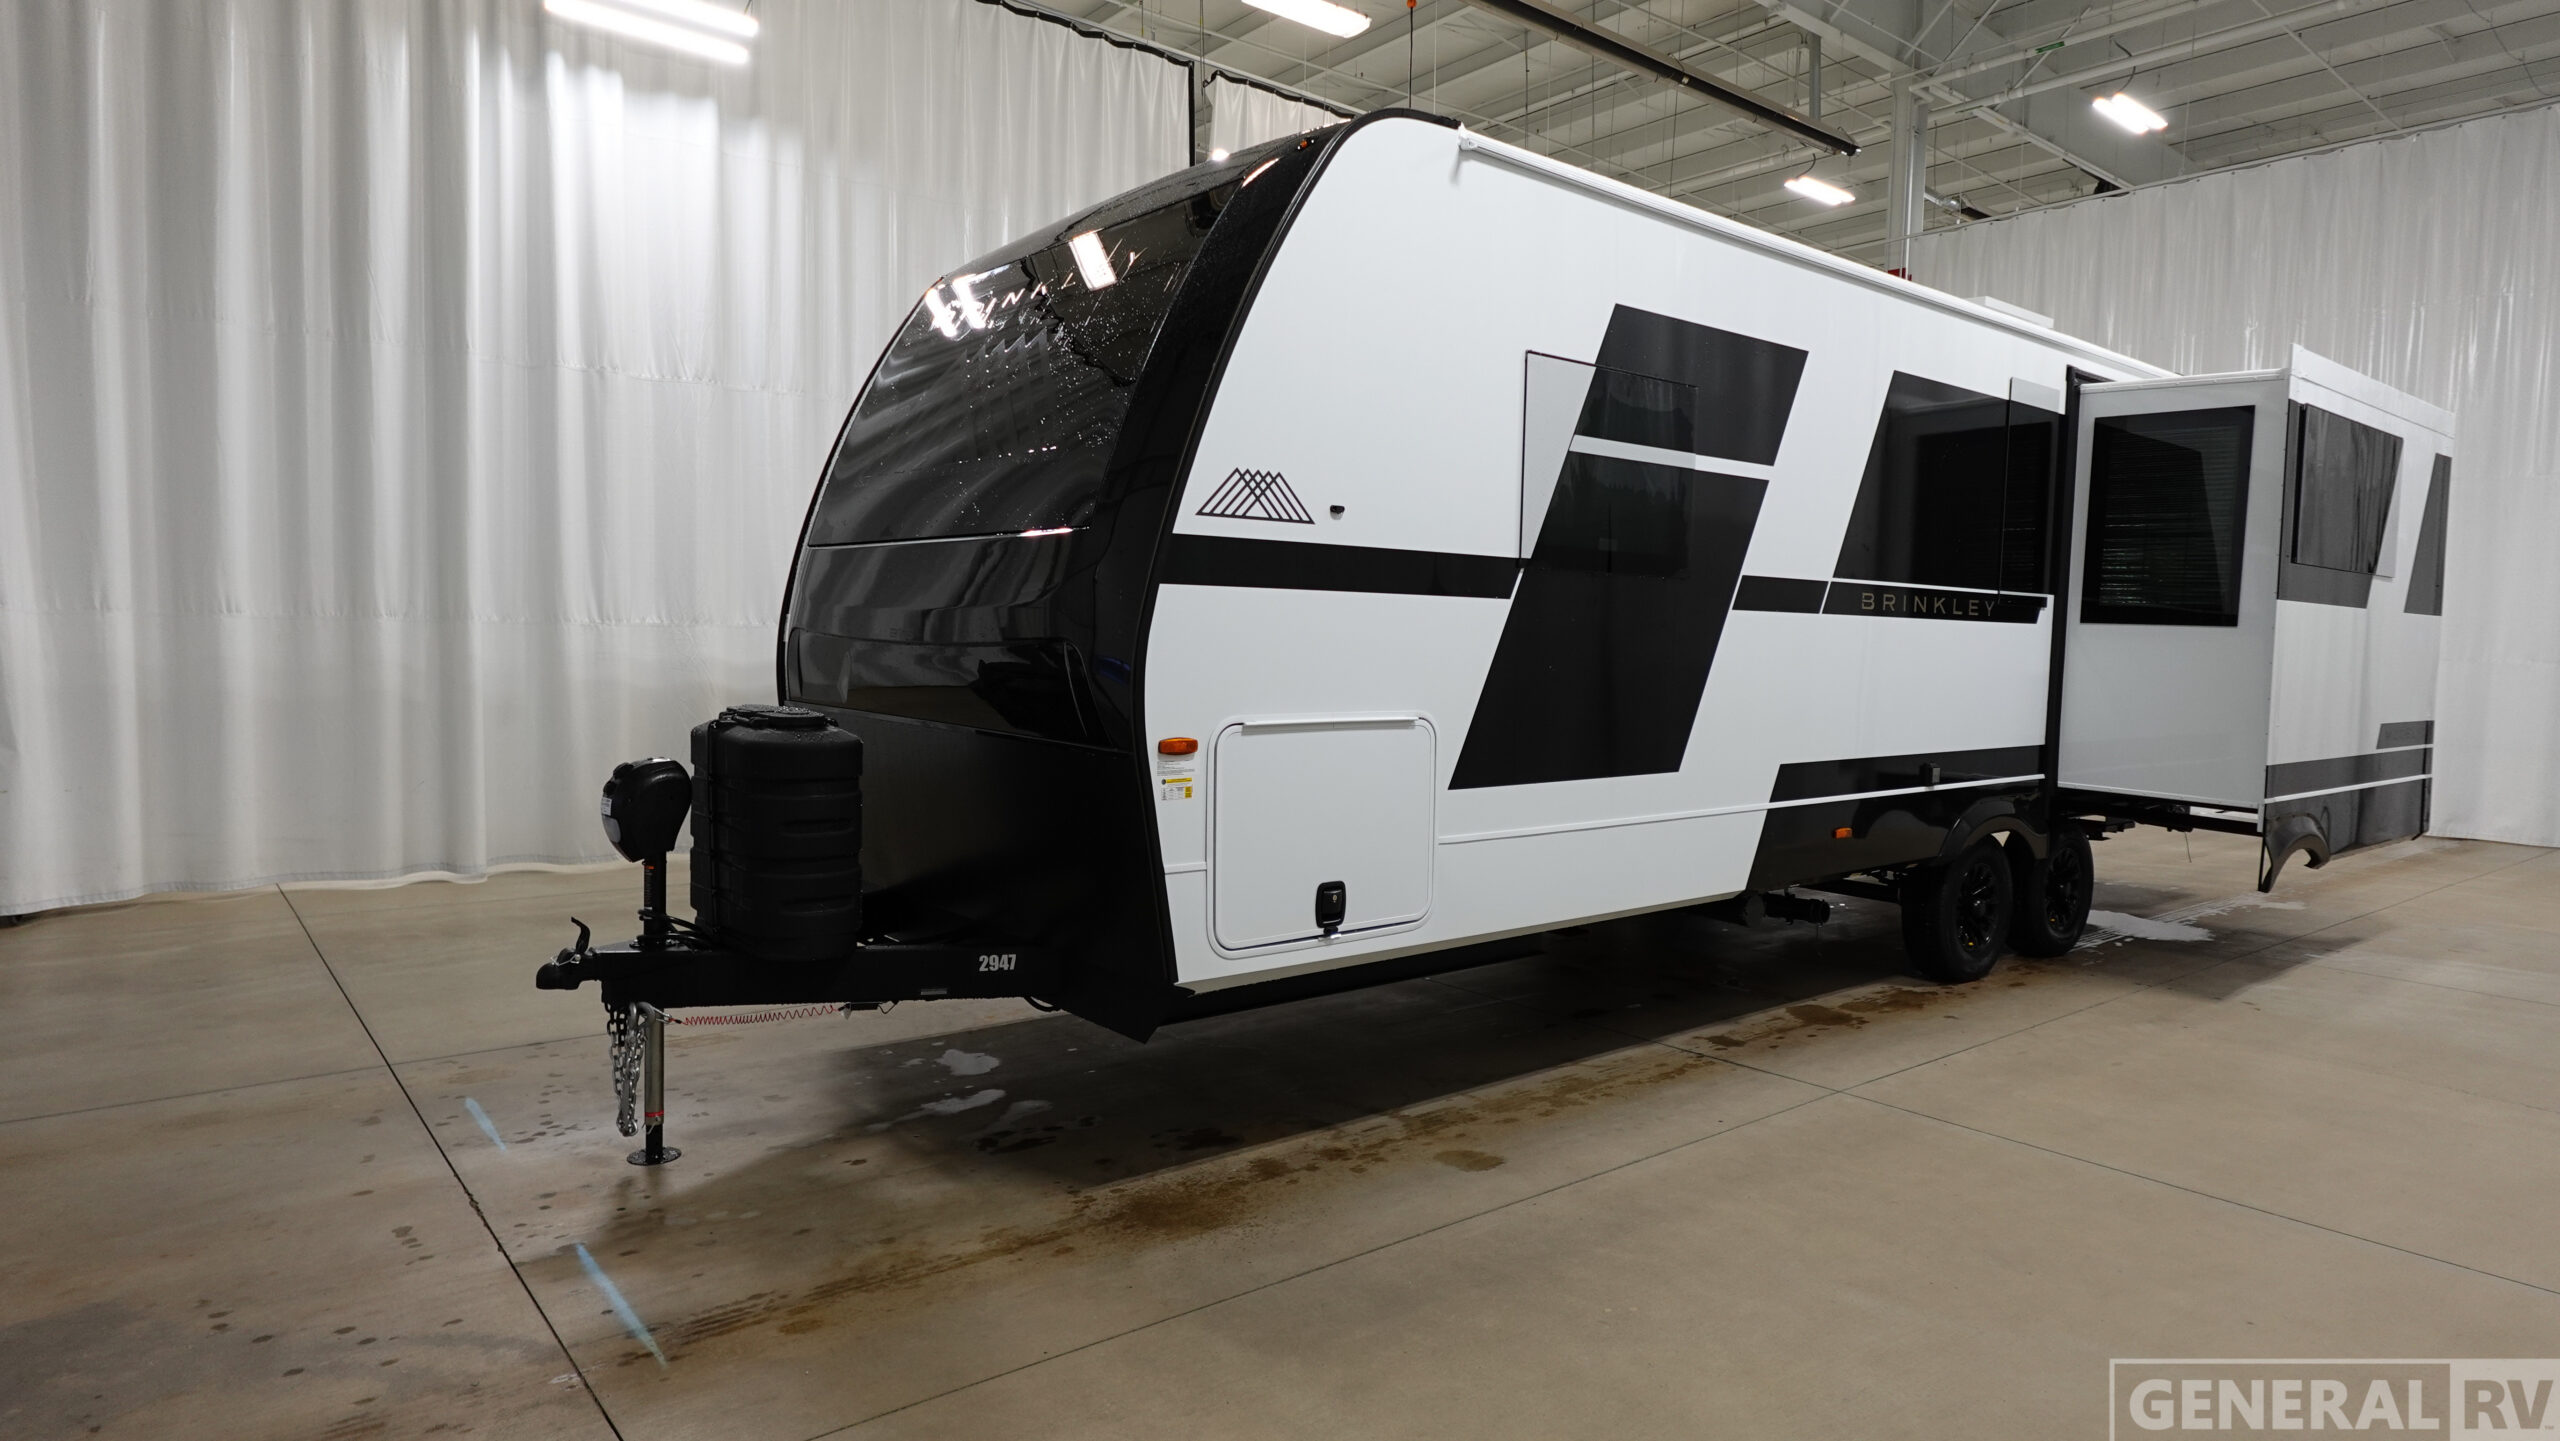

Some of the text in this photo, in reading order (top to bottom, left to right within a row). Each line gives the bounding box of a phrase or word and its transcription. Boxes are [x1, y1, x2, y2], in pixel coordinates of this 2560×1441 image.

[930, 247, 1148, 331] INKLY
[1861, 592, 1995, 617] BRINKLEY
[978, 953, 1017, 972] 2947
